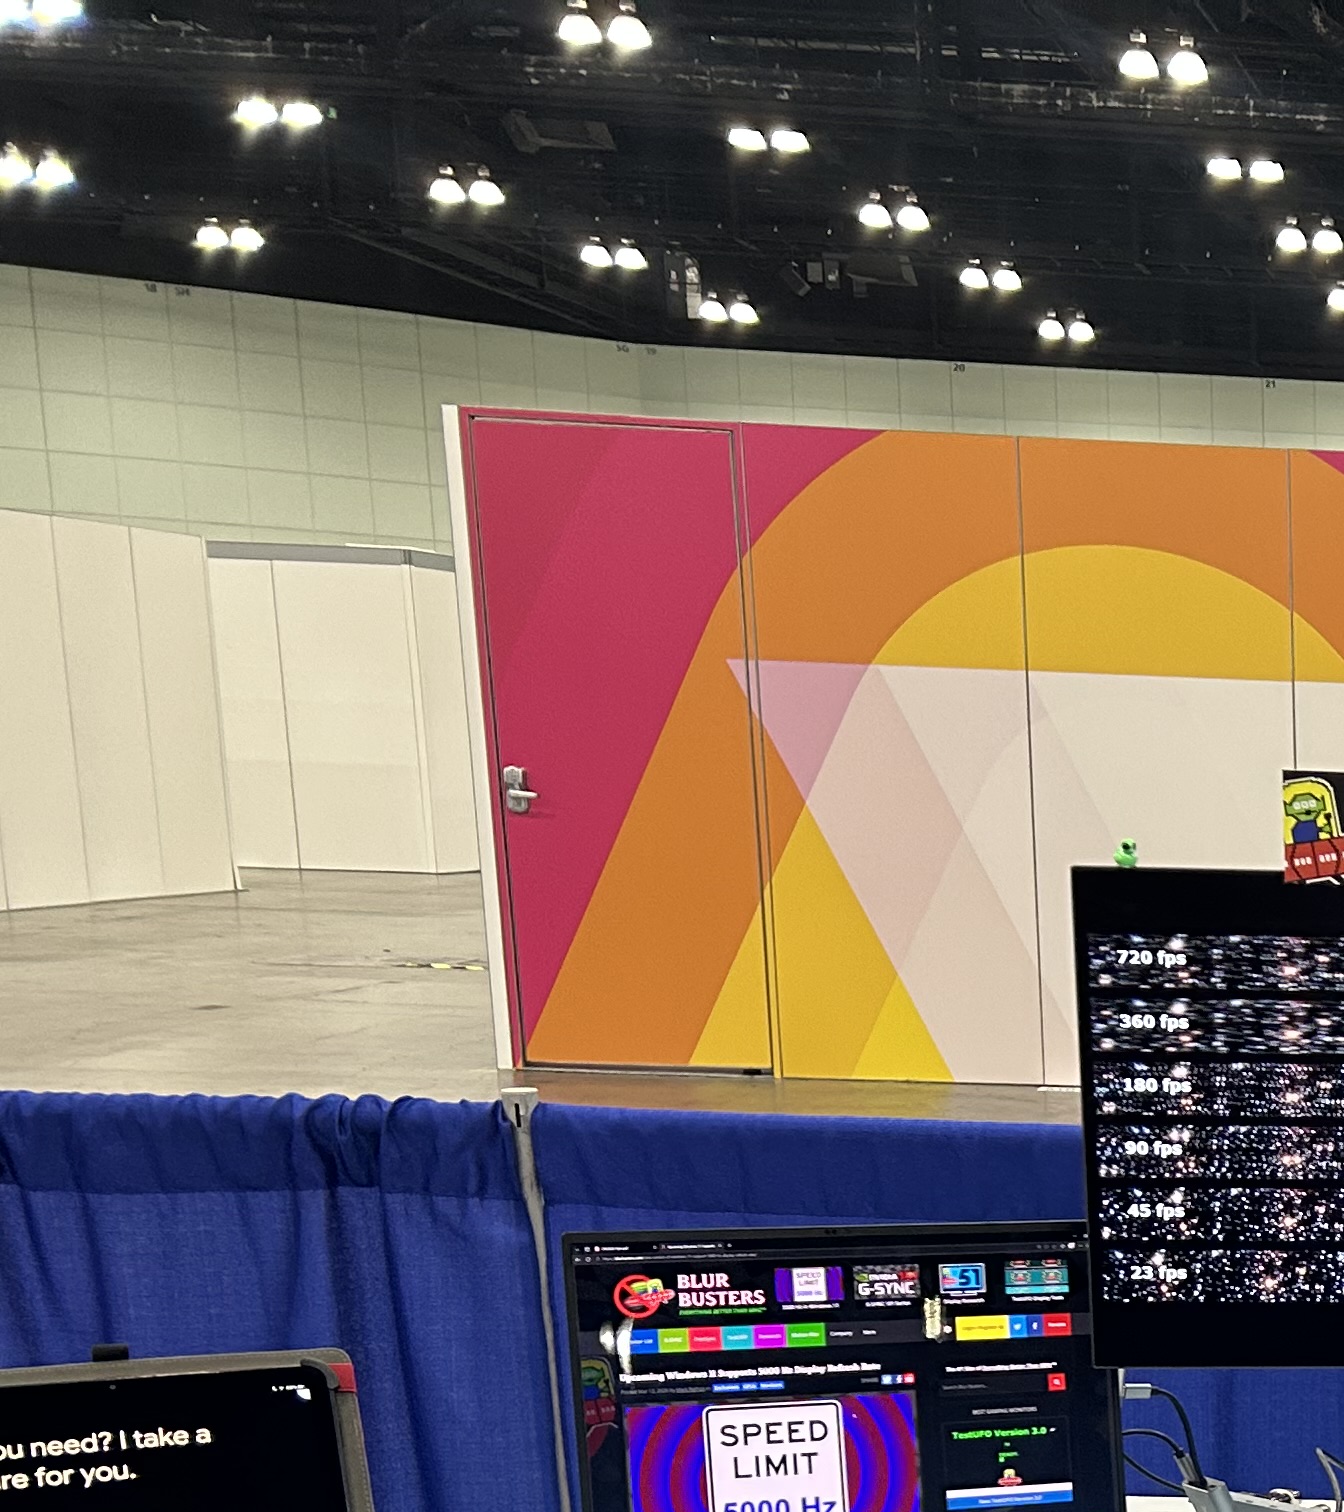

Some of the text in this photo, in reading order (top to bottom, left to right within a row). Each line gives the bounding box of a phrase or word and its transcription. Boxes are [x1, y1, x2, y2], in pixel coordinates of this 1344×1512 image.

[1117, 950, 1187, 968] 720 fps
[1120, 1014, 1189, 1031] 360 fps
[1124, 1078, 1192, 1096] 180 fps
[1125, 1142, 1182, 1158] 90 fps
[1127, 1204, 1185, 1221] 45 fps
[677, 1273, 729, 1289] BLUR
[959, 1269, 981, 1286] 51
[1131, 1266, 1187, 1282] 23 fps
[858, 1283, 914, 1295] G-SYNC
[679, 1290, 766, 1307] BUSTERS
[31, 1427, 212, 1457] need? I take a
[720, 1420, 828, 1447] SPEED
[952, 1430, 992, 1439] TestUFO
[994, 1429, 1029, 1437] Version
[734, 1452, 818, 1478] LIMIT
[34, 1464, 137, 1488] for you.
